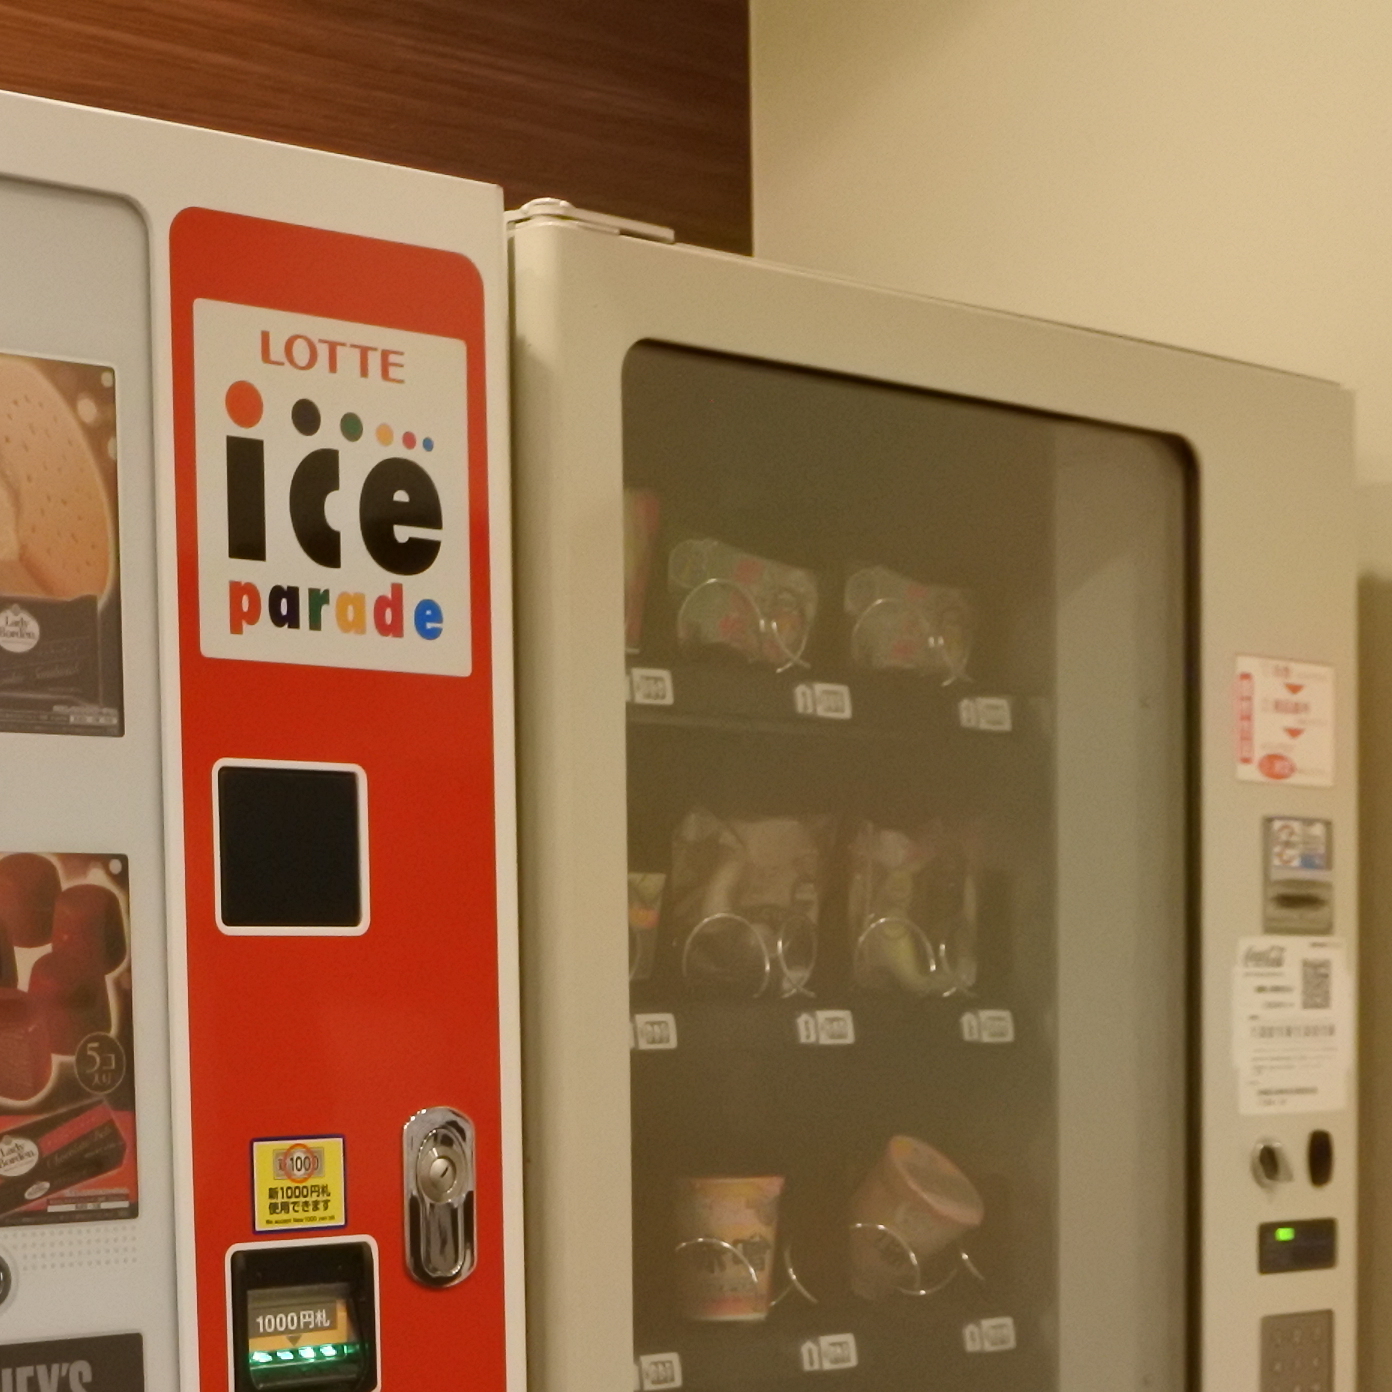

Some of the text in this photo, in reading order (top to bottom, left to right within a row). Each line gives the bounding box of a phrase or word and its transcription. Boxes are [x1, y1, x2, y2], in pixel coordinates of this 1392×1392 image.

[260, 330, 406, 384] LOTTE
[225, 380, 443, 576] ice
[228, 579, 444, 641] parade
[268, 1199, 331, 1216] 使用できます
[256, 1308, 331, 1334] 1000円札
